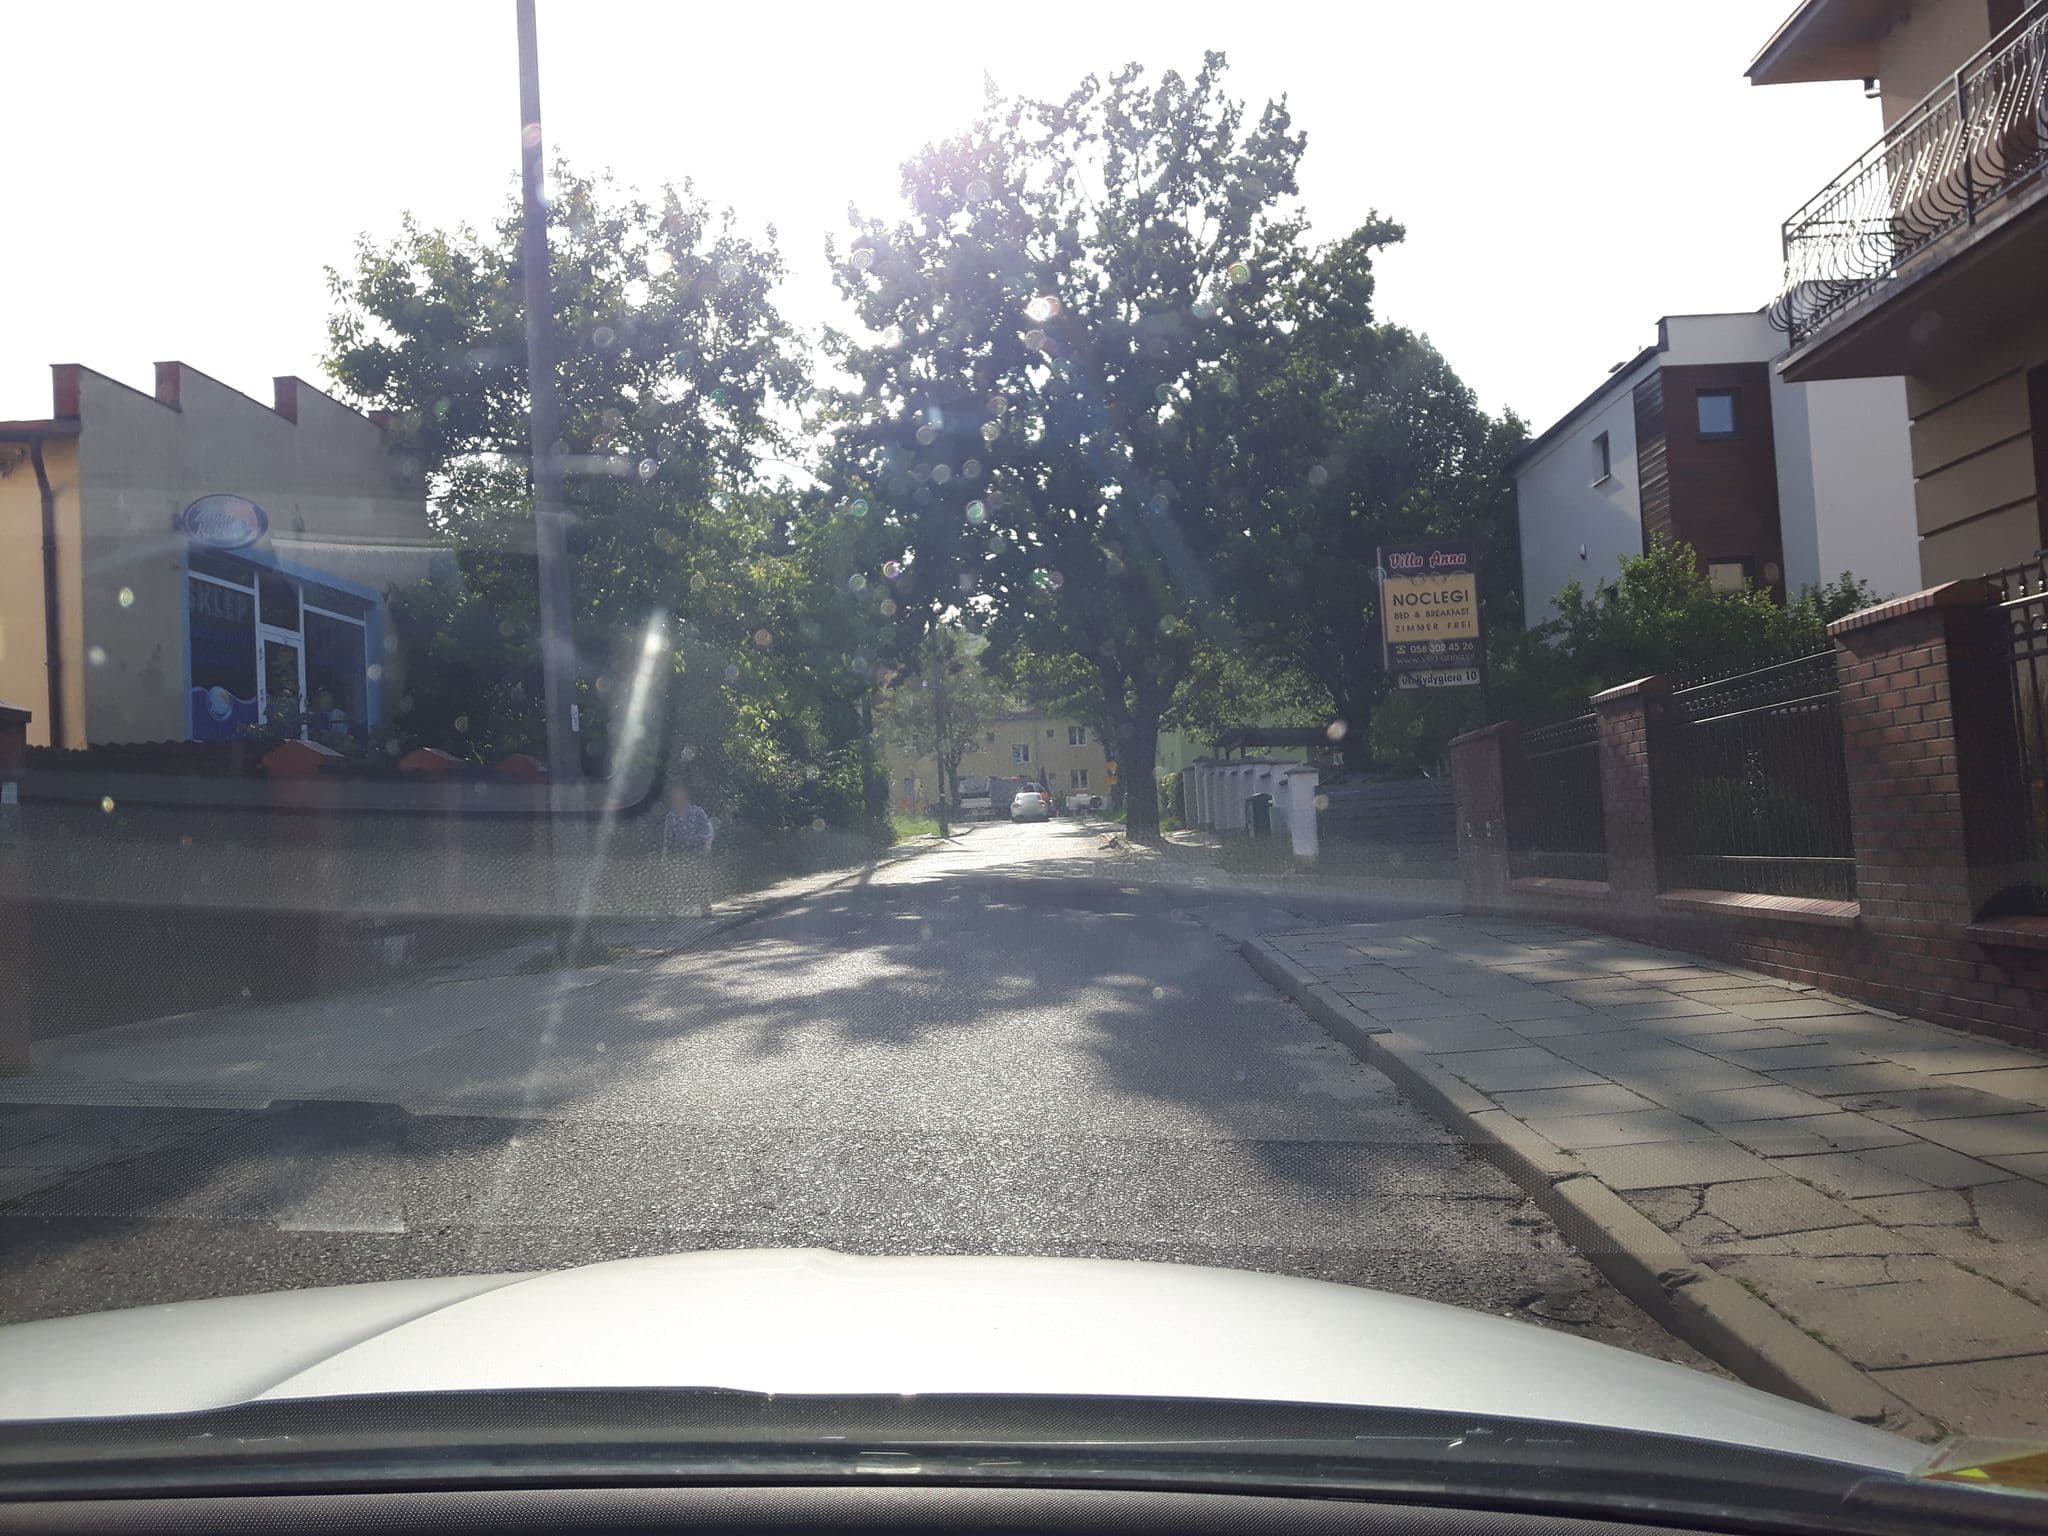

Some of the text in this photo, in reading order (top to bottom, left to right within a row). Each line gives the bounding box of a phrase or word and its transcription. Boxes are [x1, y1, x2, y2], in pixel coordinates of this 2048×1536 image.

[1389, 550, 1466, 569] Villa Anna
[1392, 589, 1469, 606] NOCLEGI
[1425, 608, 1470, 617] BREAKFAST
[1395, 620, 1471, 633] ZIMMER FREI
[1466, 671, 1477, 681] 10
